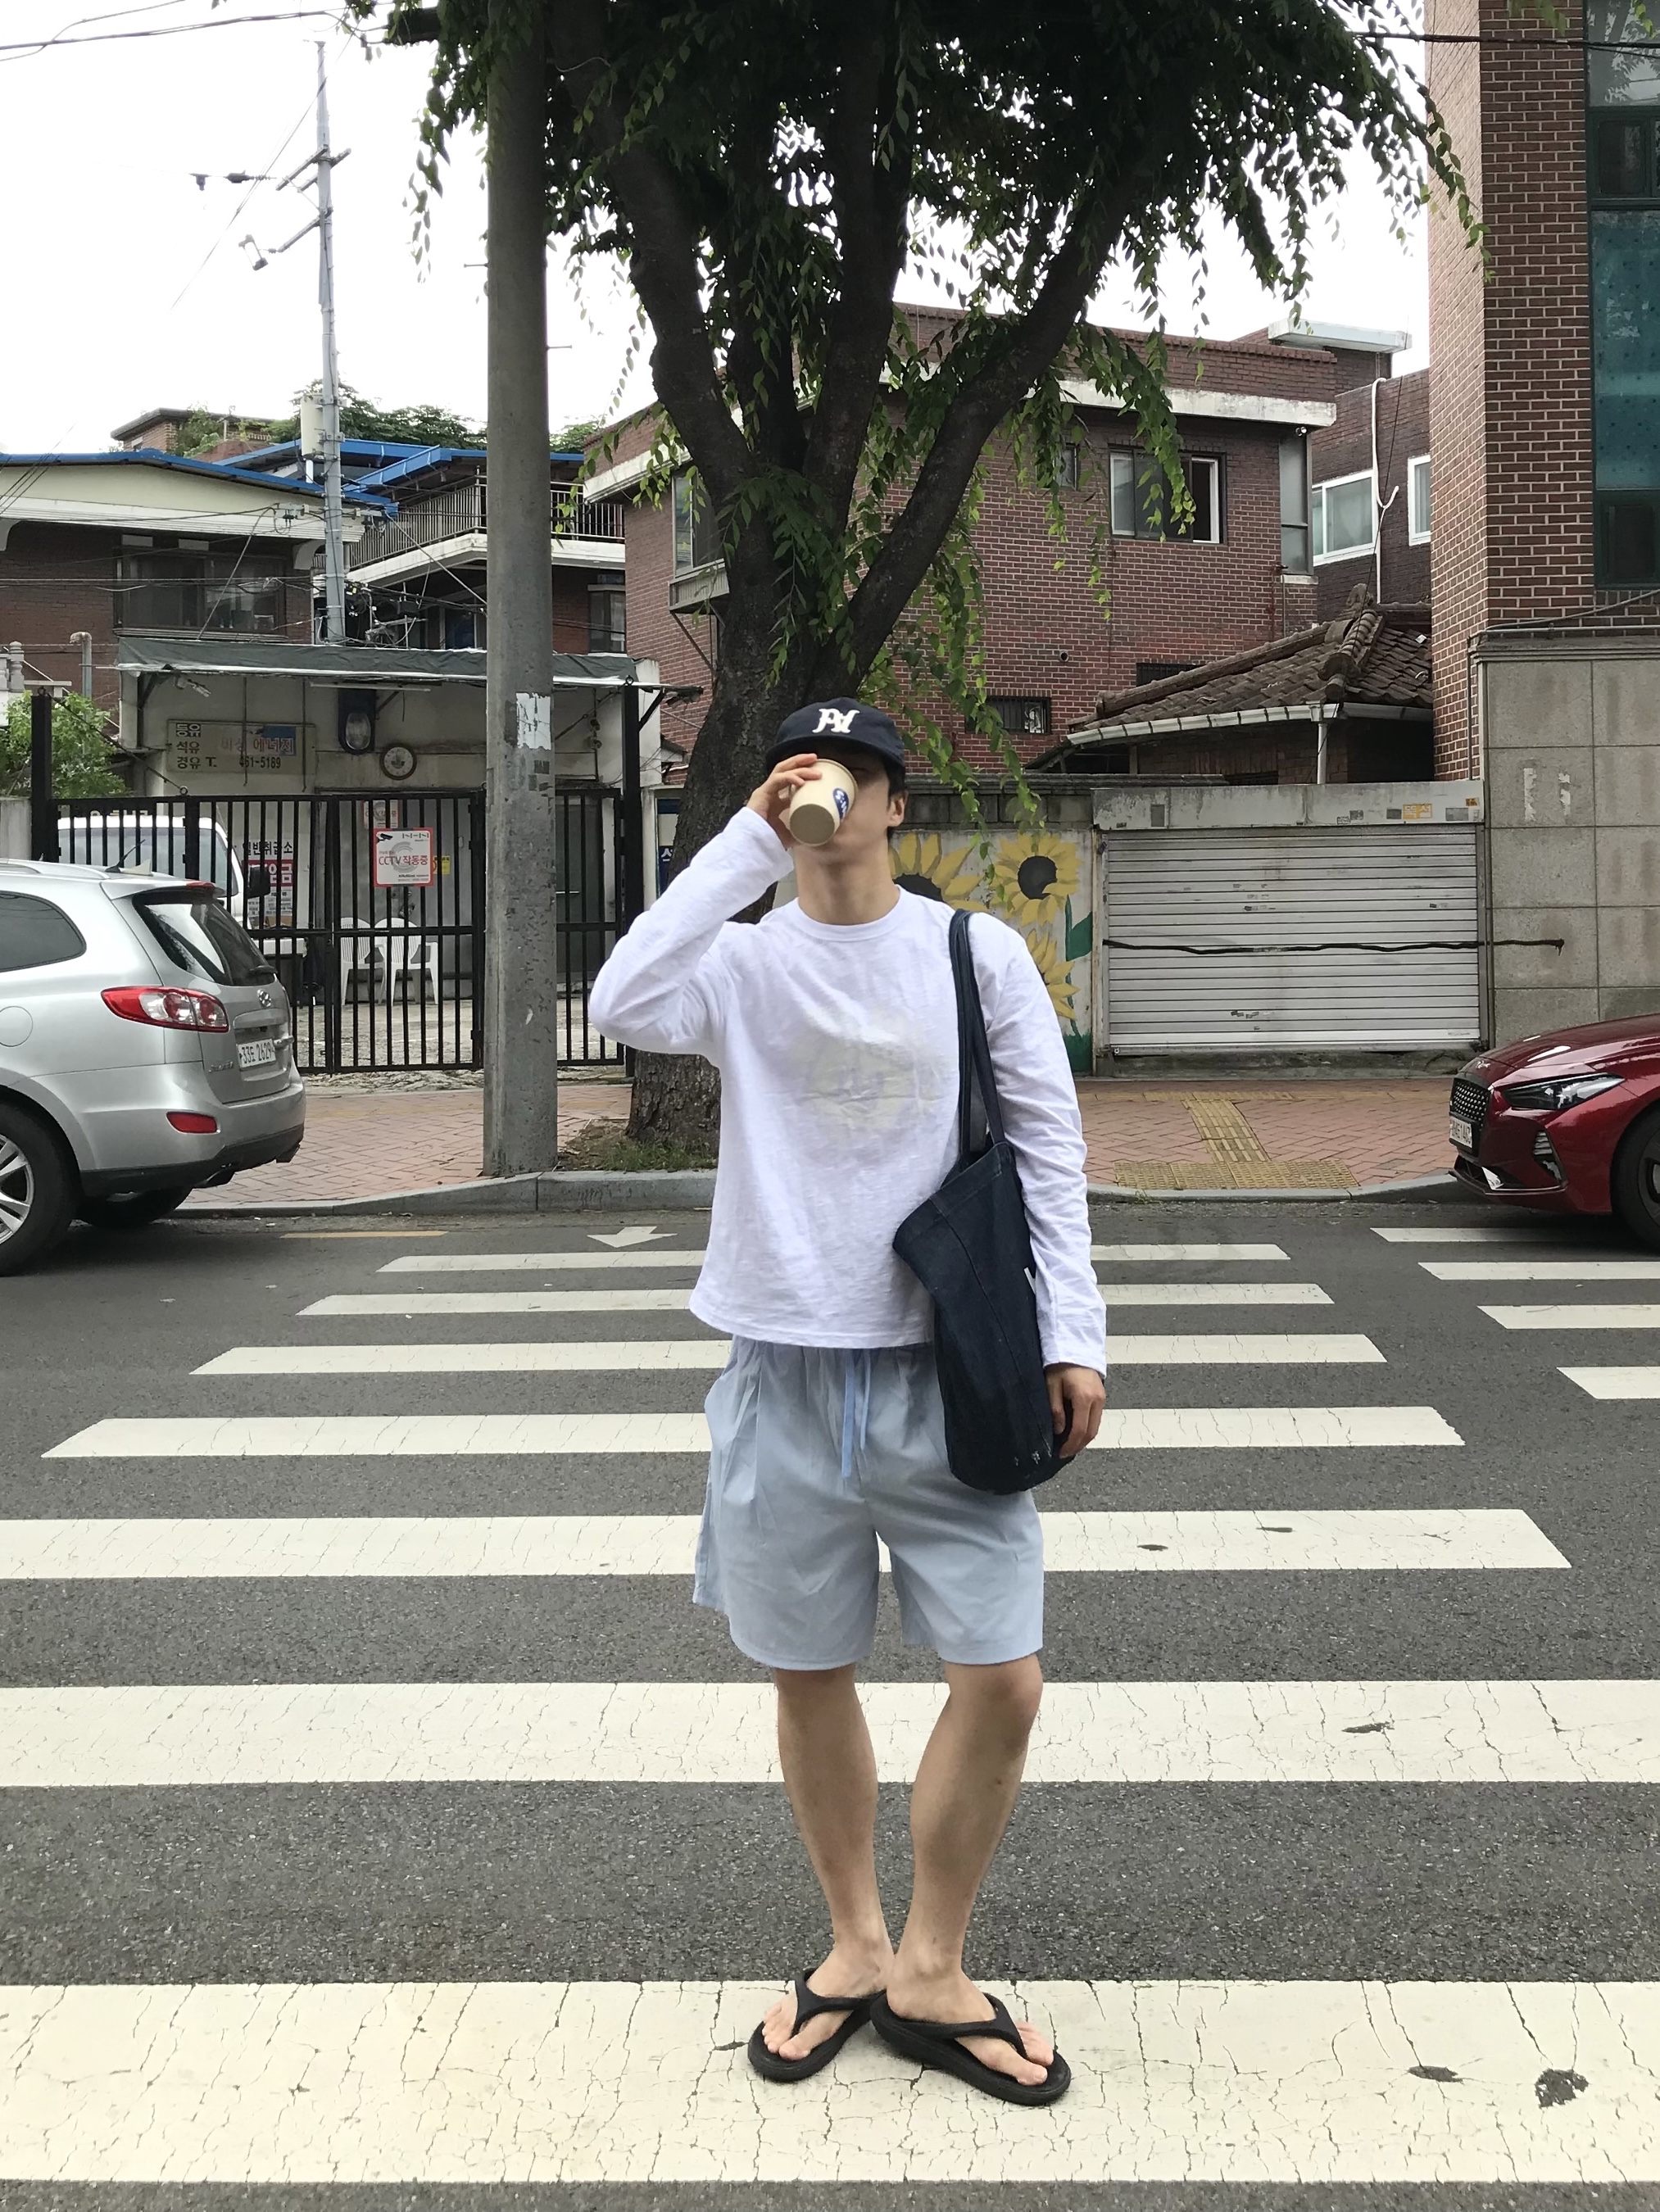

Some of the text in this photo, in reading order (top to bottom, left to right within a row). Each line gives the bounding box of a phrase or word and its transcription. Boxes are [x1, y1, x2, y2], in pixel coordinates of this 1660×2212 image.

[176, 723, 201, 737] 등유
[176, 741, 200, 754] 석유
[177, 757, 201, 769] 경유
[379, 856, 401, 865] CCTV
[402, 855, 429, 865] 작동중
